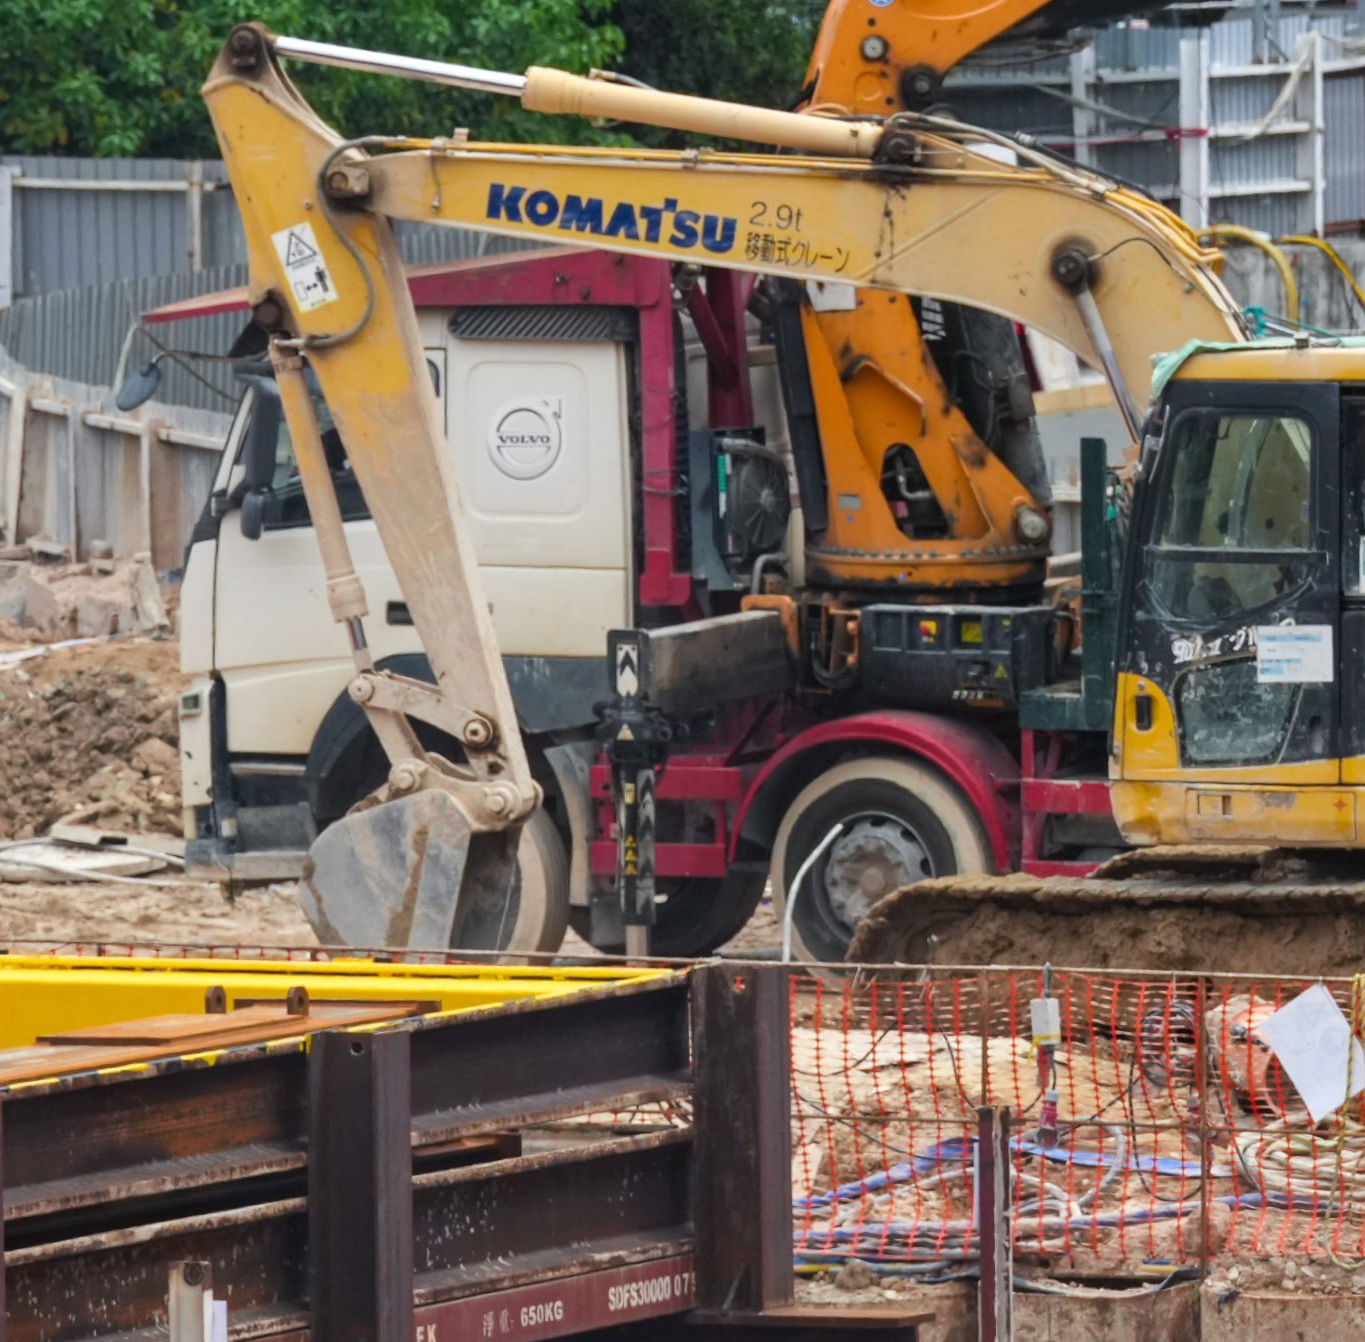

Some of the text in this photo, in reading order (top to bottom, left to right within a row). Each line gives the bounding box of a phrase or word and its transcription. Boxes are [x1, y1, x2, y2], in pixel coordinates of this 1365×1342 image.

[486, 183, 737, 254] KOMATSU
[749, 201, 803, 232] 2.9t
[745, 231, 850, 273] 移動式クレーン
[498, 434, 551, 445] VOLVO
[520, 1300, 564, 1328] 650KG
[608, 1277, 671, 1312] SDFS30000
